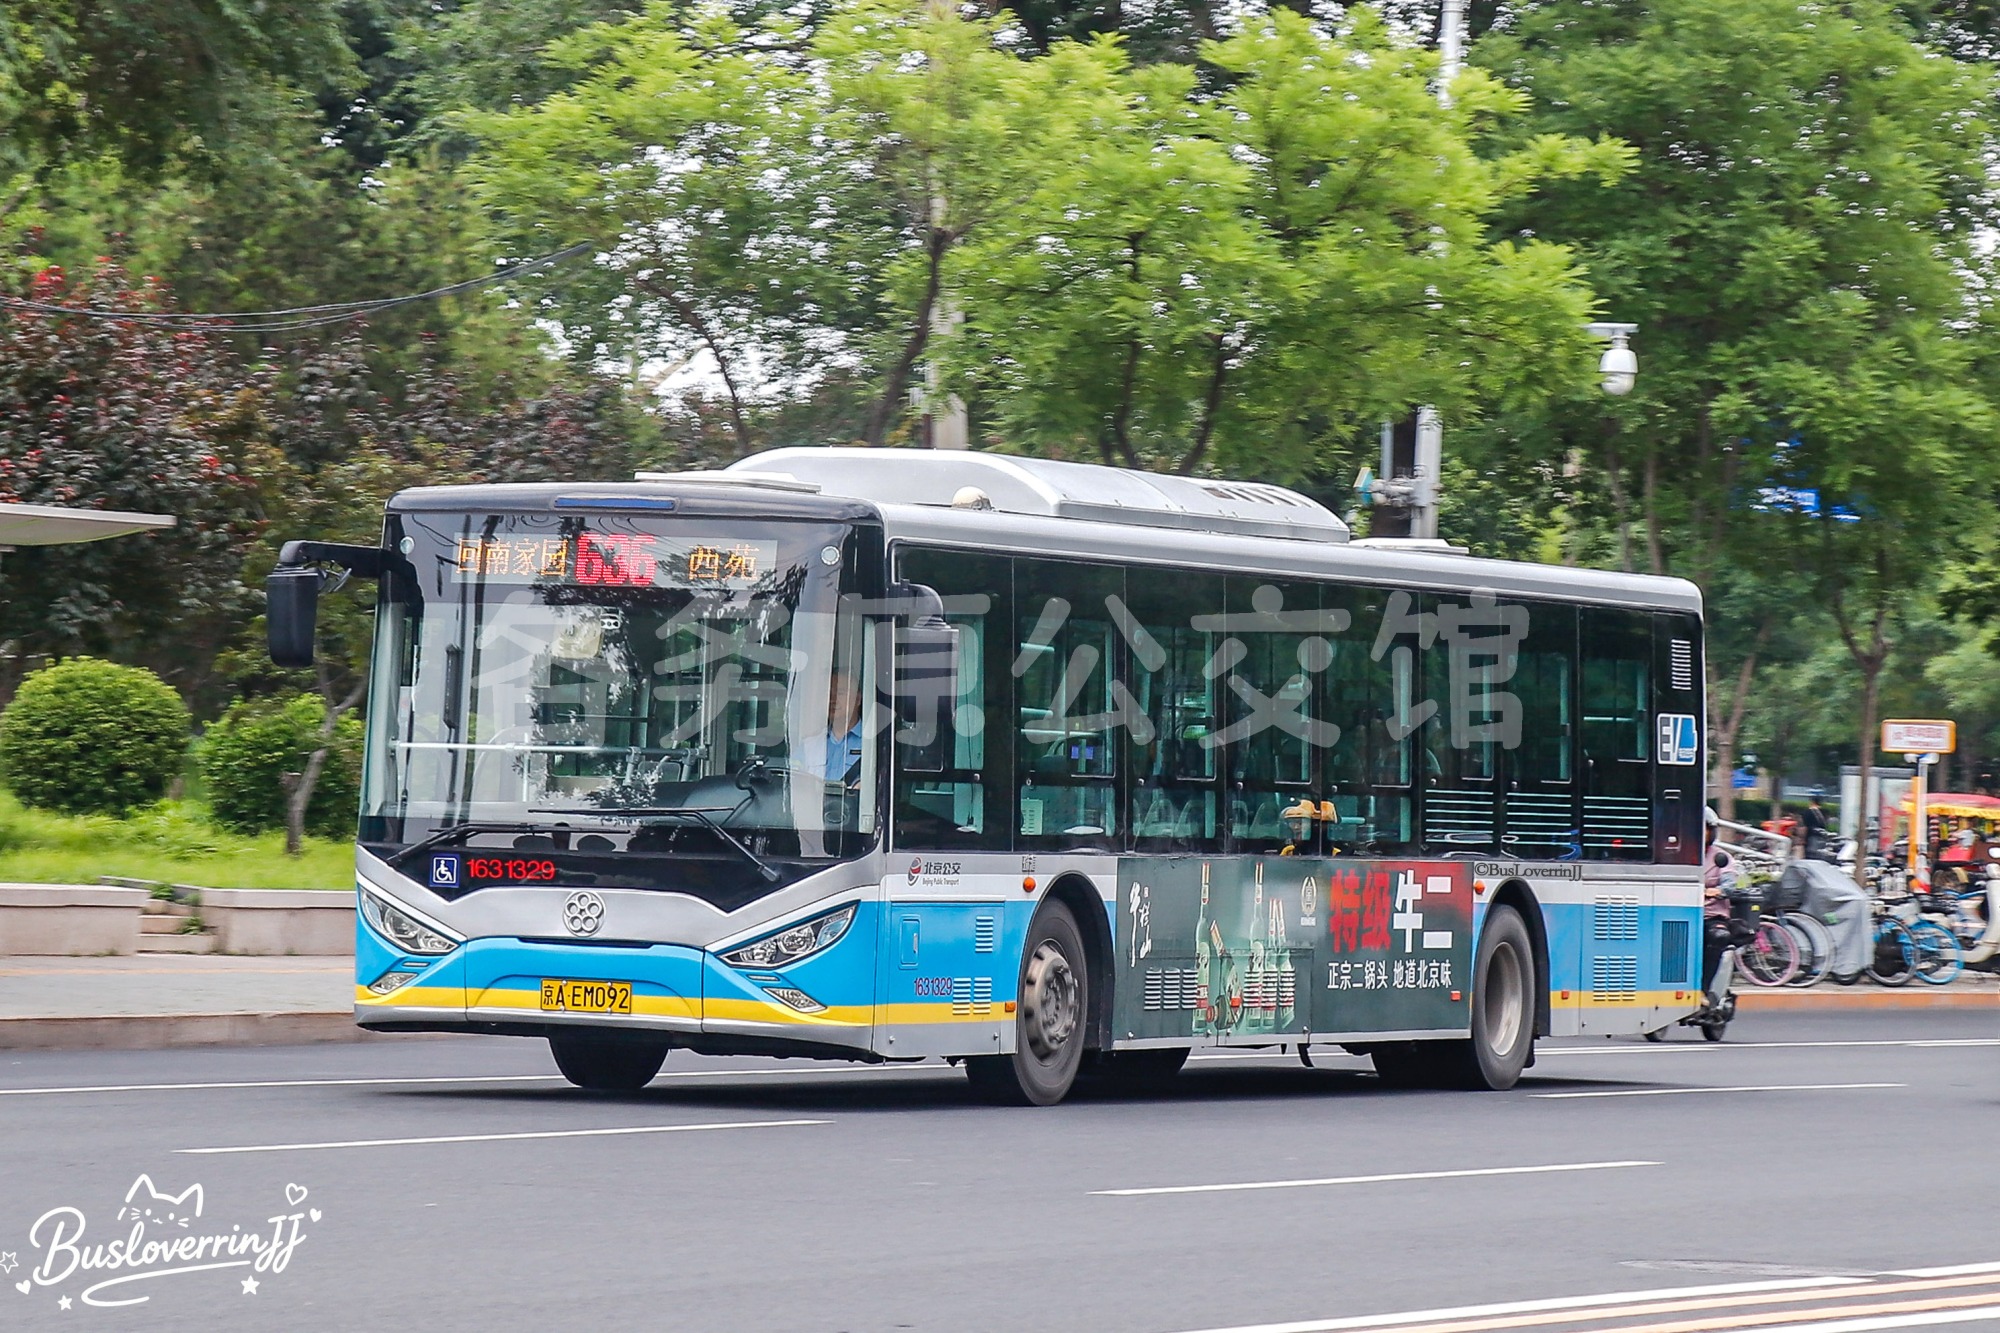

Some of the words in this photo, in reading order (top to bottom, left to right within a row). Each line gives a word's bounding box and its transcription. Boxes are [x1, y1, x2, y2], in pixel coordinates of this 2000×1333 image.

[456, 538, 568, 576] 回南家园
[575, 532, 657, 585] 636
[688, 544, 759, 581] 西苑
[467, 859, 555, 880] 1631329
[923, 861, 961, 875] 北京公交
[1327, 960, 1388, 990] 正宗二锅头
[1393, 959, 1452, 989] 地道北京味
[914, 977, 953, 996] 1631329
